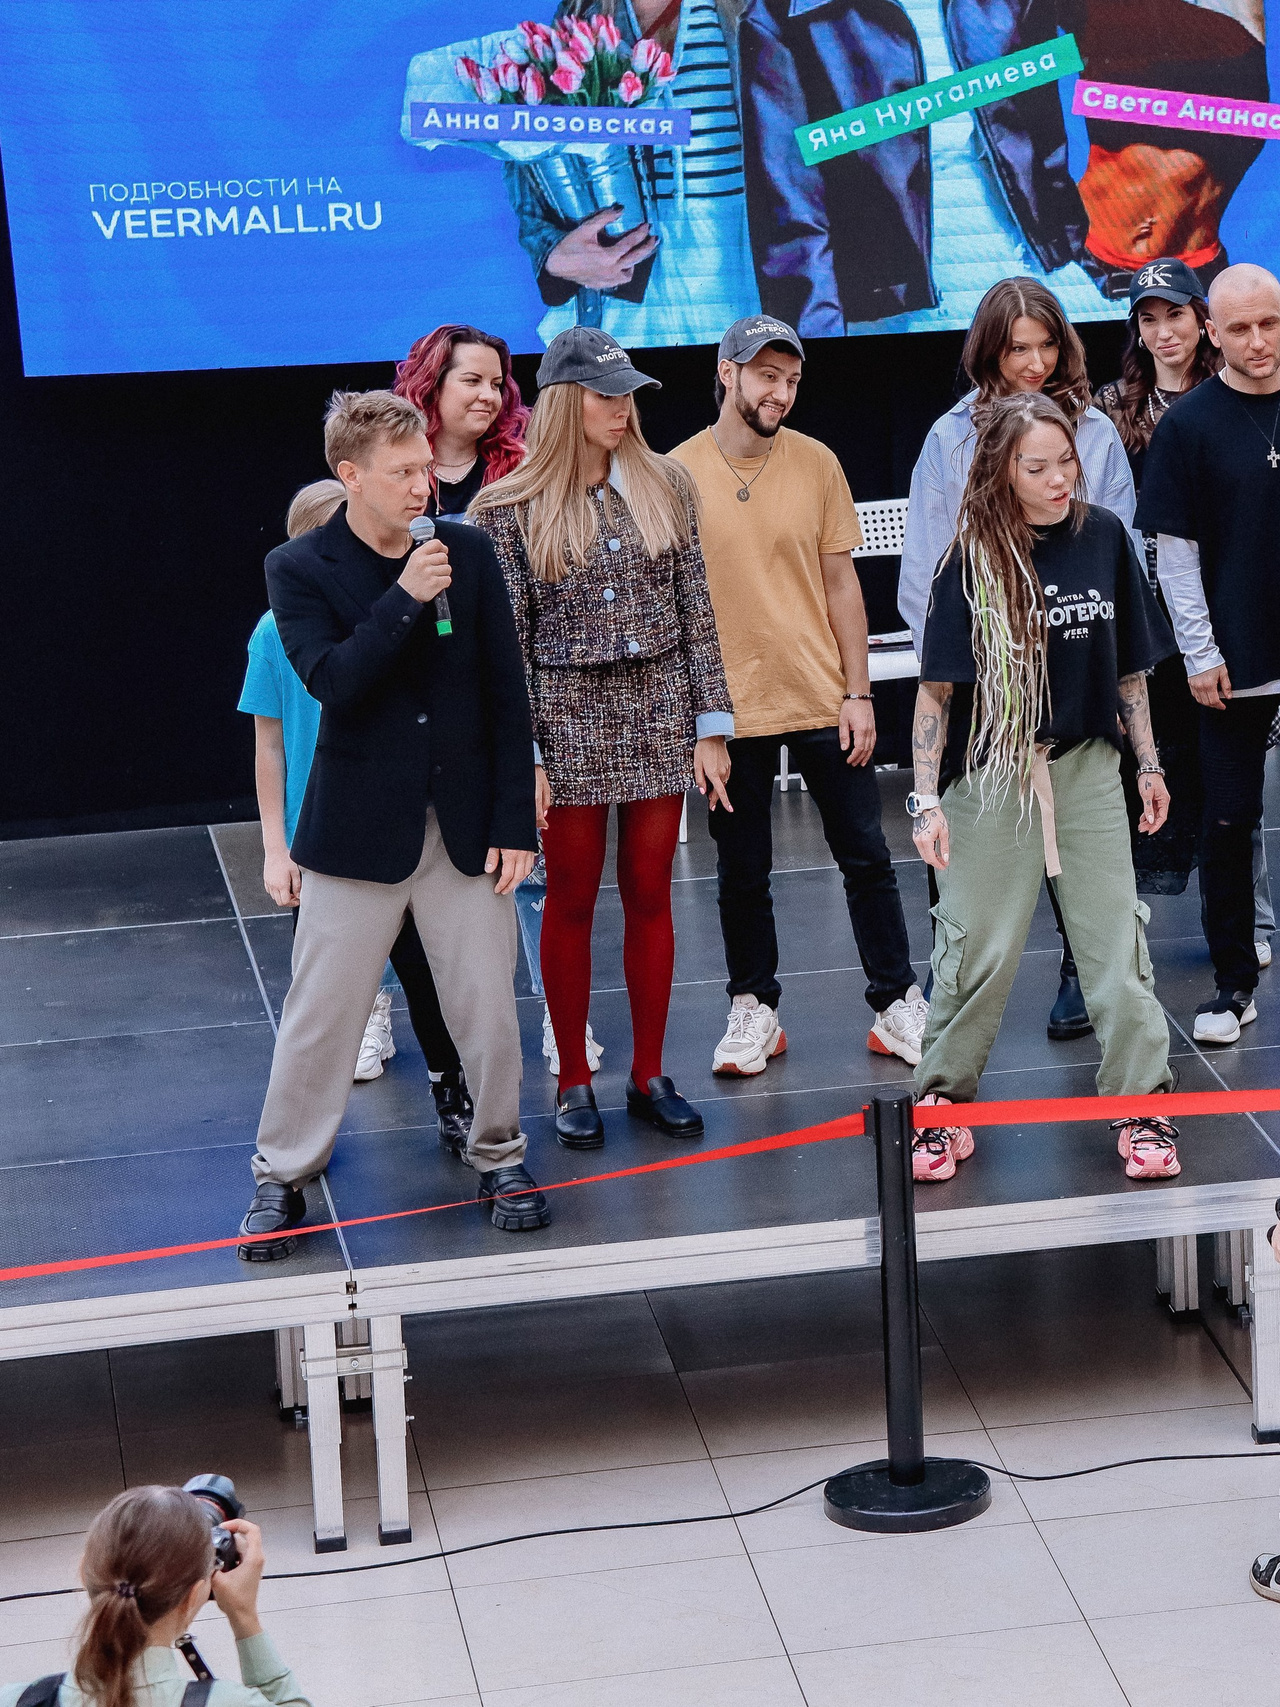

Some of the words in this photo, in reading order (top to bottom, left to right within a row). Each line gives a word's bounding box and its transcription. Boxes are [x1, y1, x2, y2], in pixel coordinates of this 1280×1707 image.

[807, 118, 866, 151] Яна
[875, 52, 1057, 126] Нургалиева
[1082, 86, 1168, 116] Света
[423, 107, 499, 130] Анна
[511, 110, 674, 135] Лозовская
[89, 177, 298, 206] ПОДРОБНОСТИ
[306, 176, 343, 196] НА
[91, 200, 383, 240] VEERMALL.RU
[1056, 593, 1085, 604] БИТВА
[1036, 601, 1115, 628] ЛОГЕРОВ
